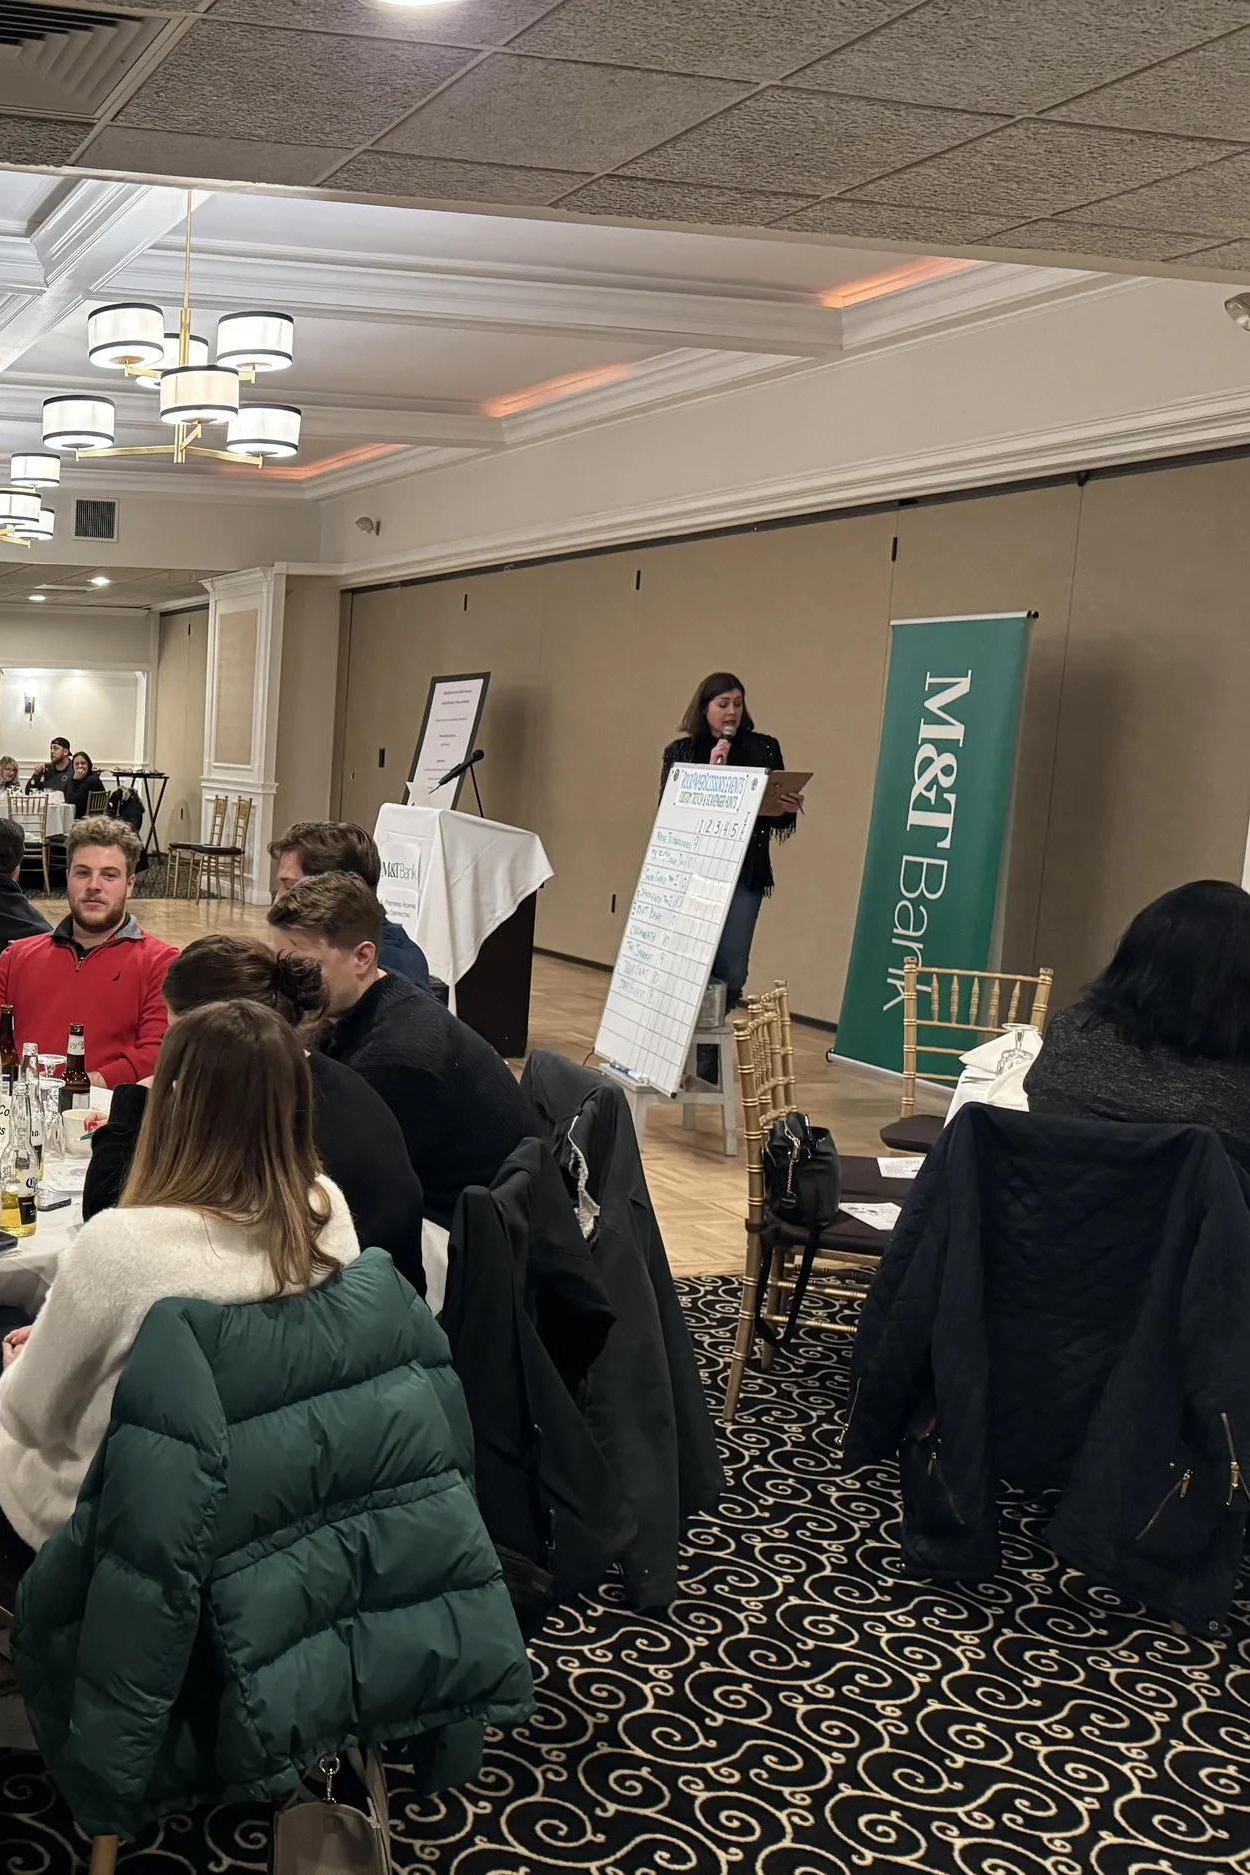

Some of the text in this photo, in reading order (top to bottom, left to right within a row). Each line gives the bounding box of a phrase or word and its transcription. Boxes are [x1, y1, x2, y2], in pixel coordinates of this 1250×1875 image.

[705, 819, 713, 833] 2
[714, 820, 721, 834] 3
[723, 821, 730, 836] 4
[730, 823, 738, 838] 5
[882, 669, 972, 1012] M&T Bank
[381, 861, 418, 880] M&T Bank
